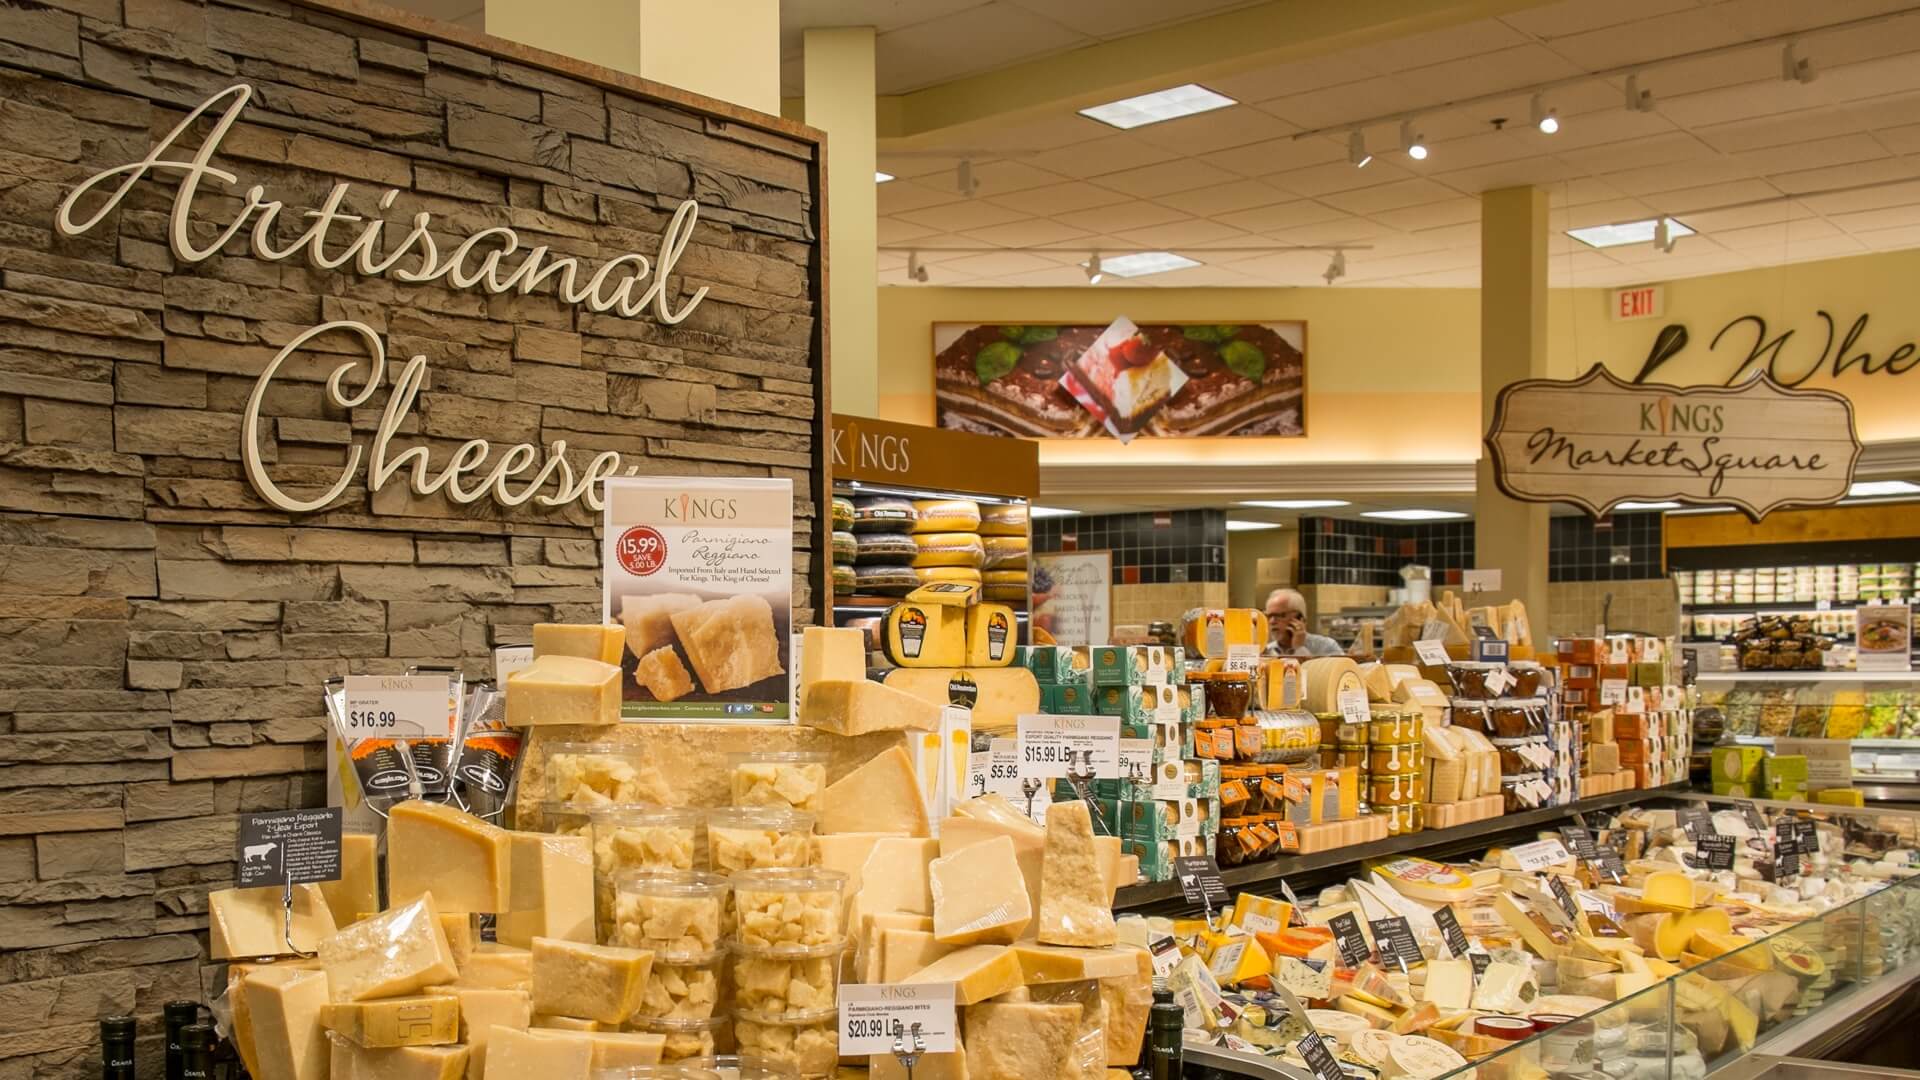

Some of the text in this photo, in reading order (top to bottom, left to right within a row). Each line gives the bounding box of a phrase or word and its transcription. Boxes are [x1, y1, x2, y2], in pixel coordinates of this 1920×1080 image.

[55, 84, 709, 325] Artisanal
[1620, 289, 1654, 318] EXIT
[241, 321, 637, 513] Cheese
[1639, 397, 1724, 435] KINGS
[832, 424, 910, 472] KINGS
[1527, 428, 1828, 496] Market Square
[664, 494, 737, 521] KINGS
[623, 537, 658, 554] 15.99
[682, 530, 771, 550] Parmigiano
[633, 553, 652, 561] SAVE
[692, 546, 760, 566] Reggiano
[669, 567, 695, 575] Imported
[714, 567, 726, 575] Italy
[723, 575, 738, 584] King
[350, 710, 396, 728] $16.99
[1025, 746, 1055, 762] $15.99
[1058, 746, 1071, 762] LB
[991, 764, 1018, 778] $5.99
[294, 822, 318, 831] Export
[848, 1019, 882, 1038] $20.99
